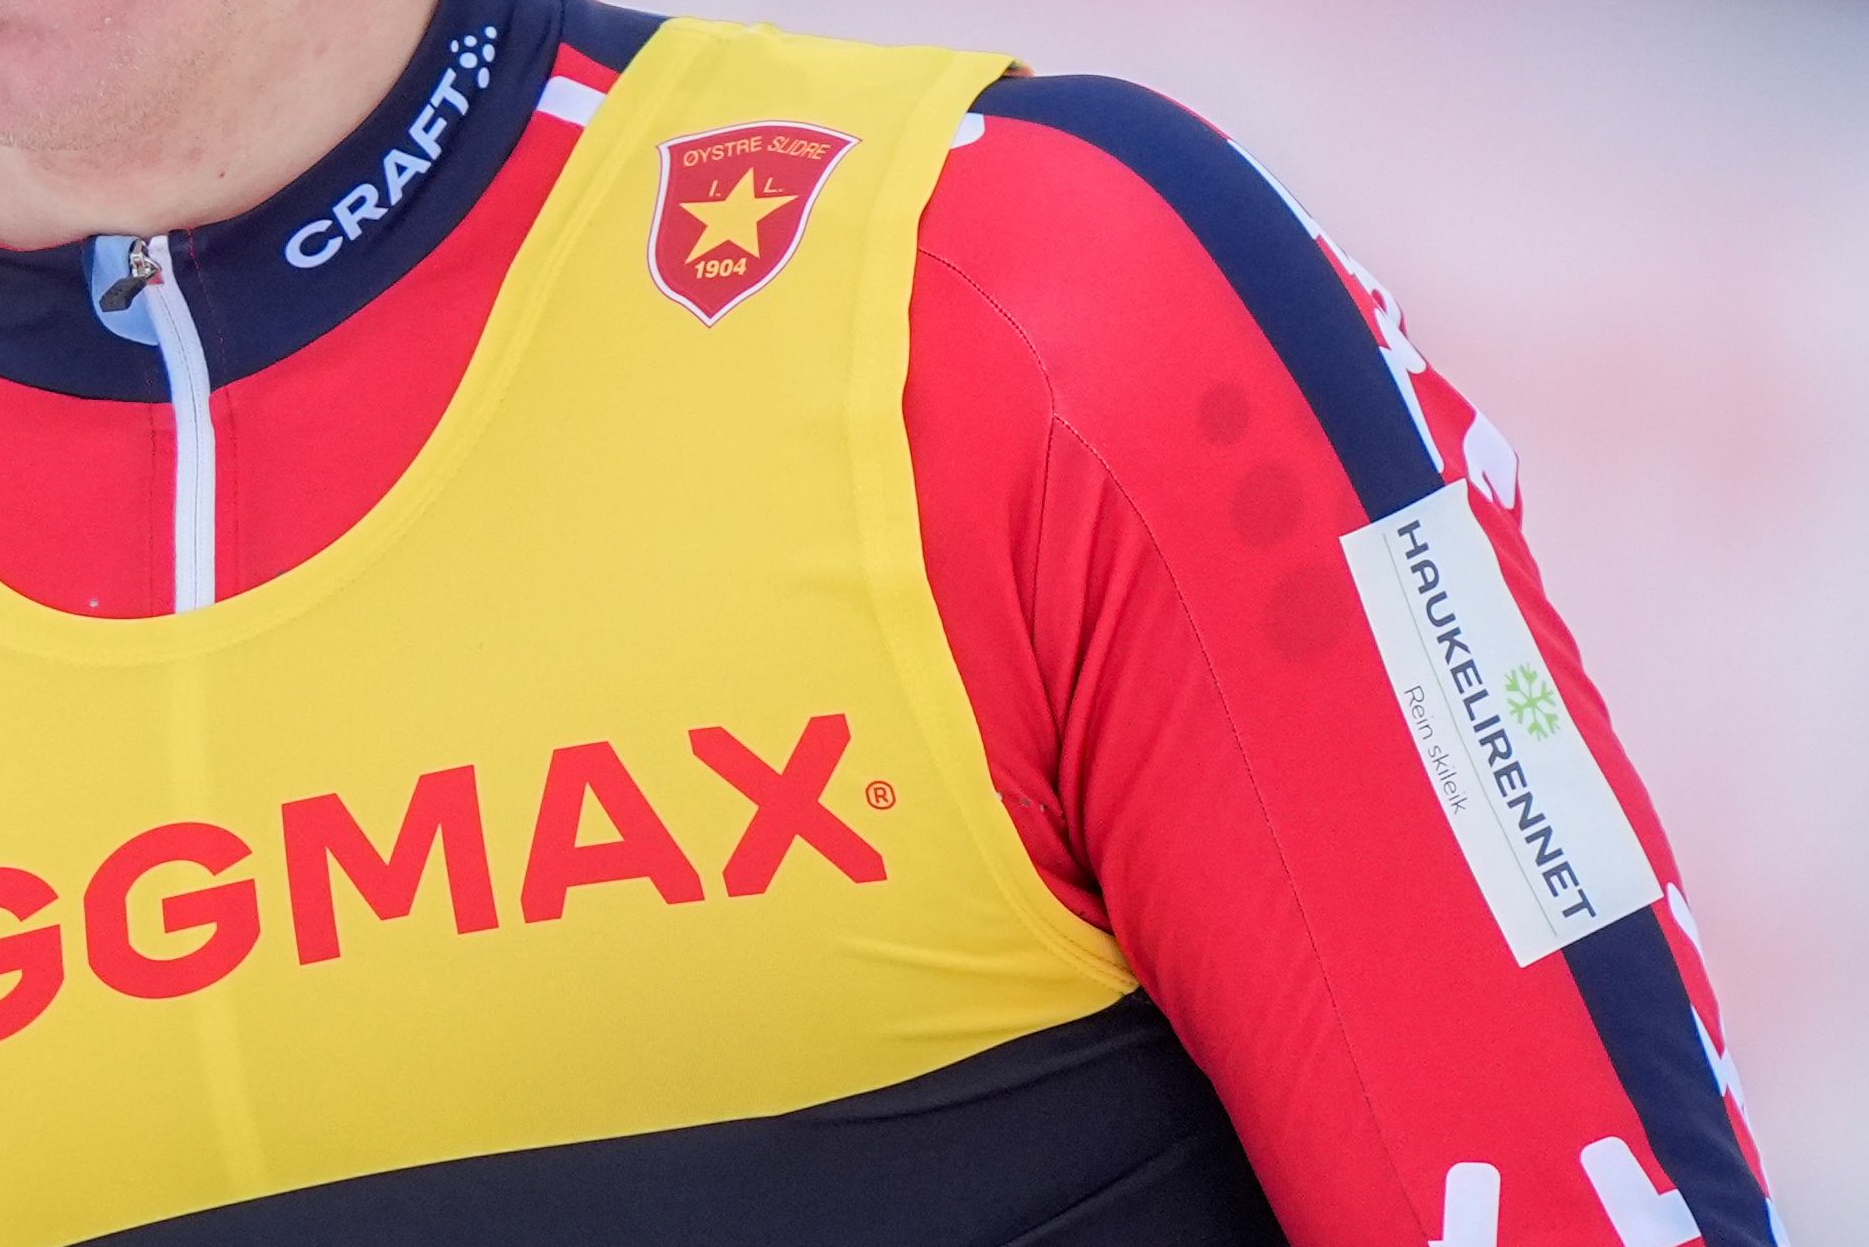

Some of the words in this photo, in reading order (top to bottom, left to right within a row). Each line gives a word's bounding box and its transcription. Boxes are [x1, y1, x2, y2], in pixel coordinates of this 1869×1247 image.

[284, 68, 470, 269] CRAFT
[683, 136, 763, 167] ØYSTRE
[767, 135, 831, 160] SLIDRE
[694, 257, 747, 279] 1904
[1397, 520, 1597, 930] HAUKELIRENNET
[1404, 685, 1433, 740] Rein
[1428, 745, 1468, 816] skileik
